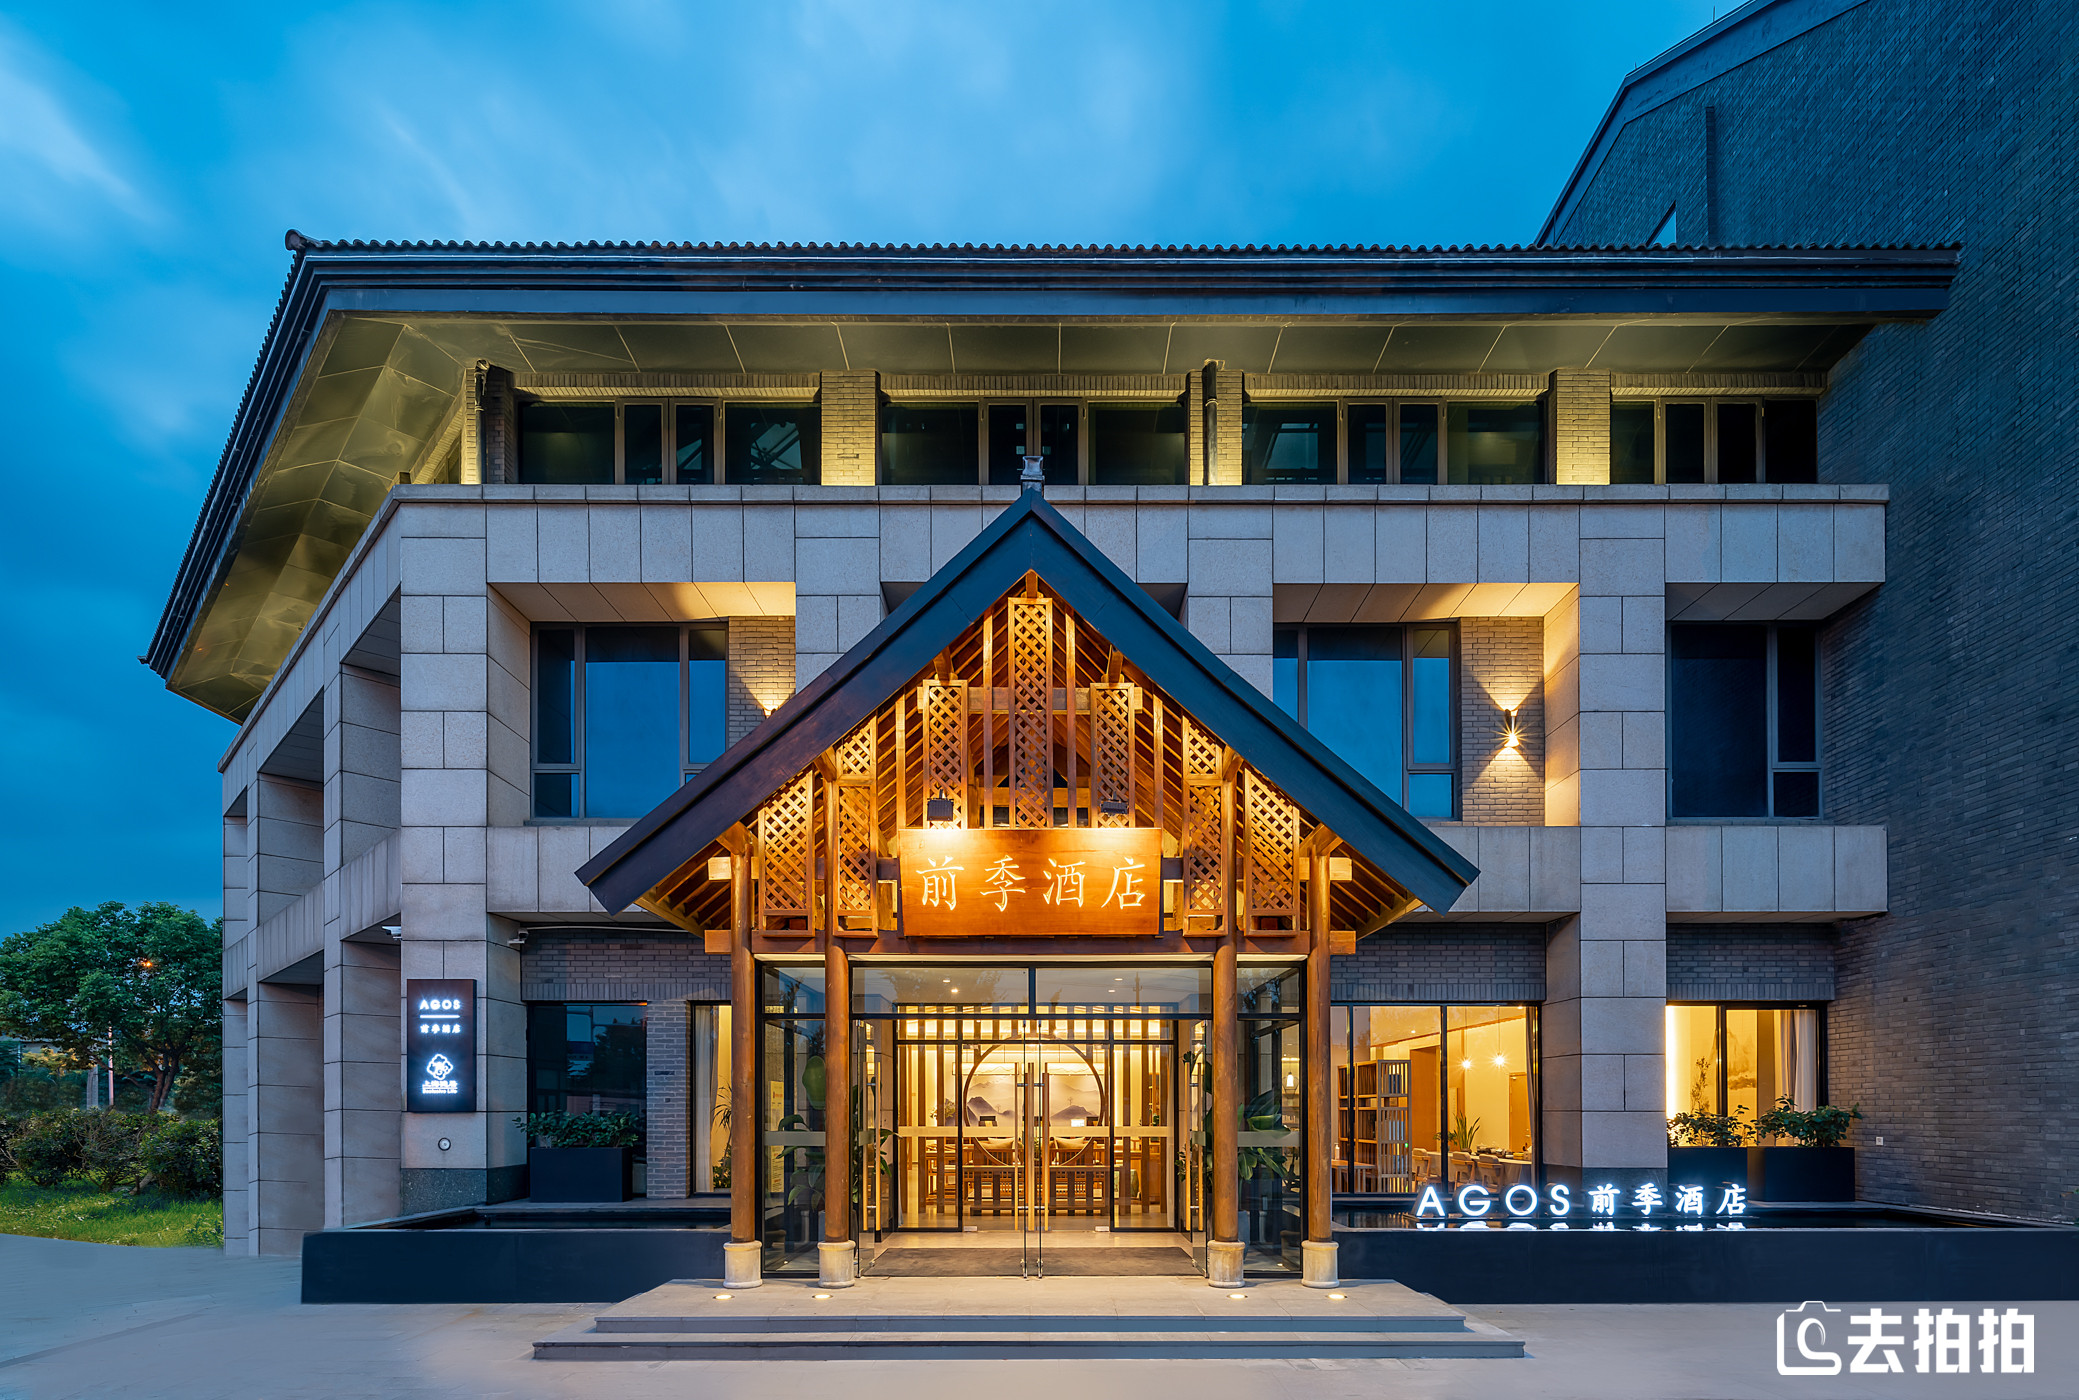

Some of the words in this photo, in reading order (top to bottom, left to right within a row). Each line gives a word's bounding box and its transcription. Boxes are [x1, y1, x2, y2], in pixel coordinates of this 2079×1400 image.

[915, 855, 1146, 912] 前季酒店
[420, 999, 461, 1010] AGOS
[1416, 1184, 1570, 1217] AGOS
[1588, 1183, 1747, 1216] 前季酒店
